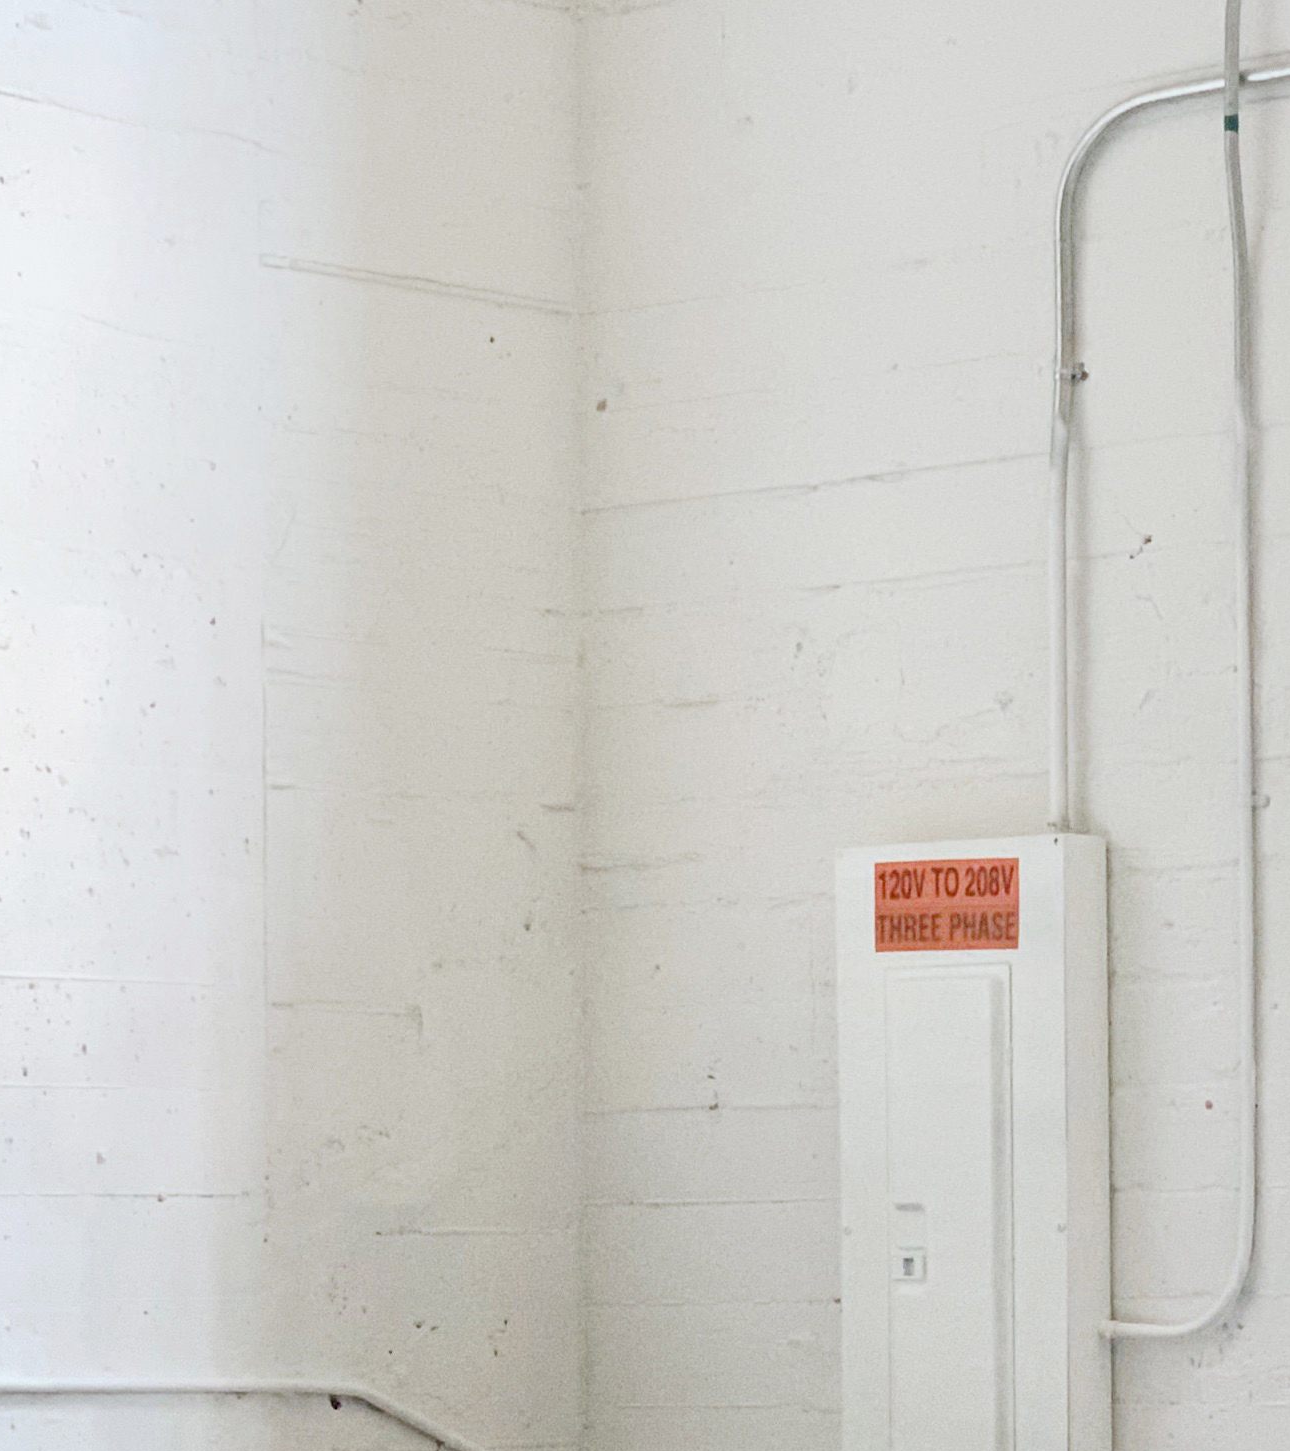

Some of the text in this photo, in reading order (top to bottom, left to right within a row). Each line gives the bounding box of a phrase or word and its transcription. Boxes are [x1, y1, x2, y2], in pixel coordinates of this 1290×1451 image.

[878, 864, 1015, 900] 120V TO 208V
[877, 910, 1016, 944] THREE PHASE
